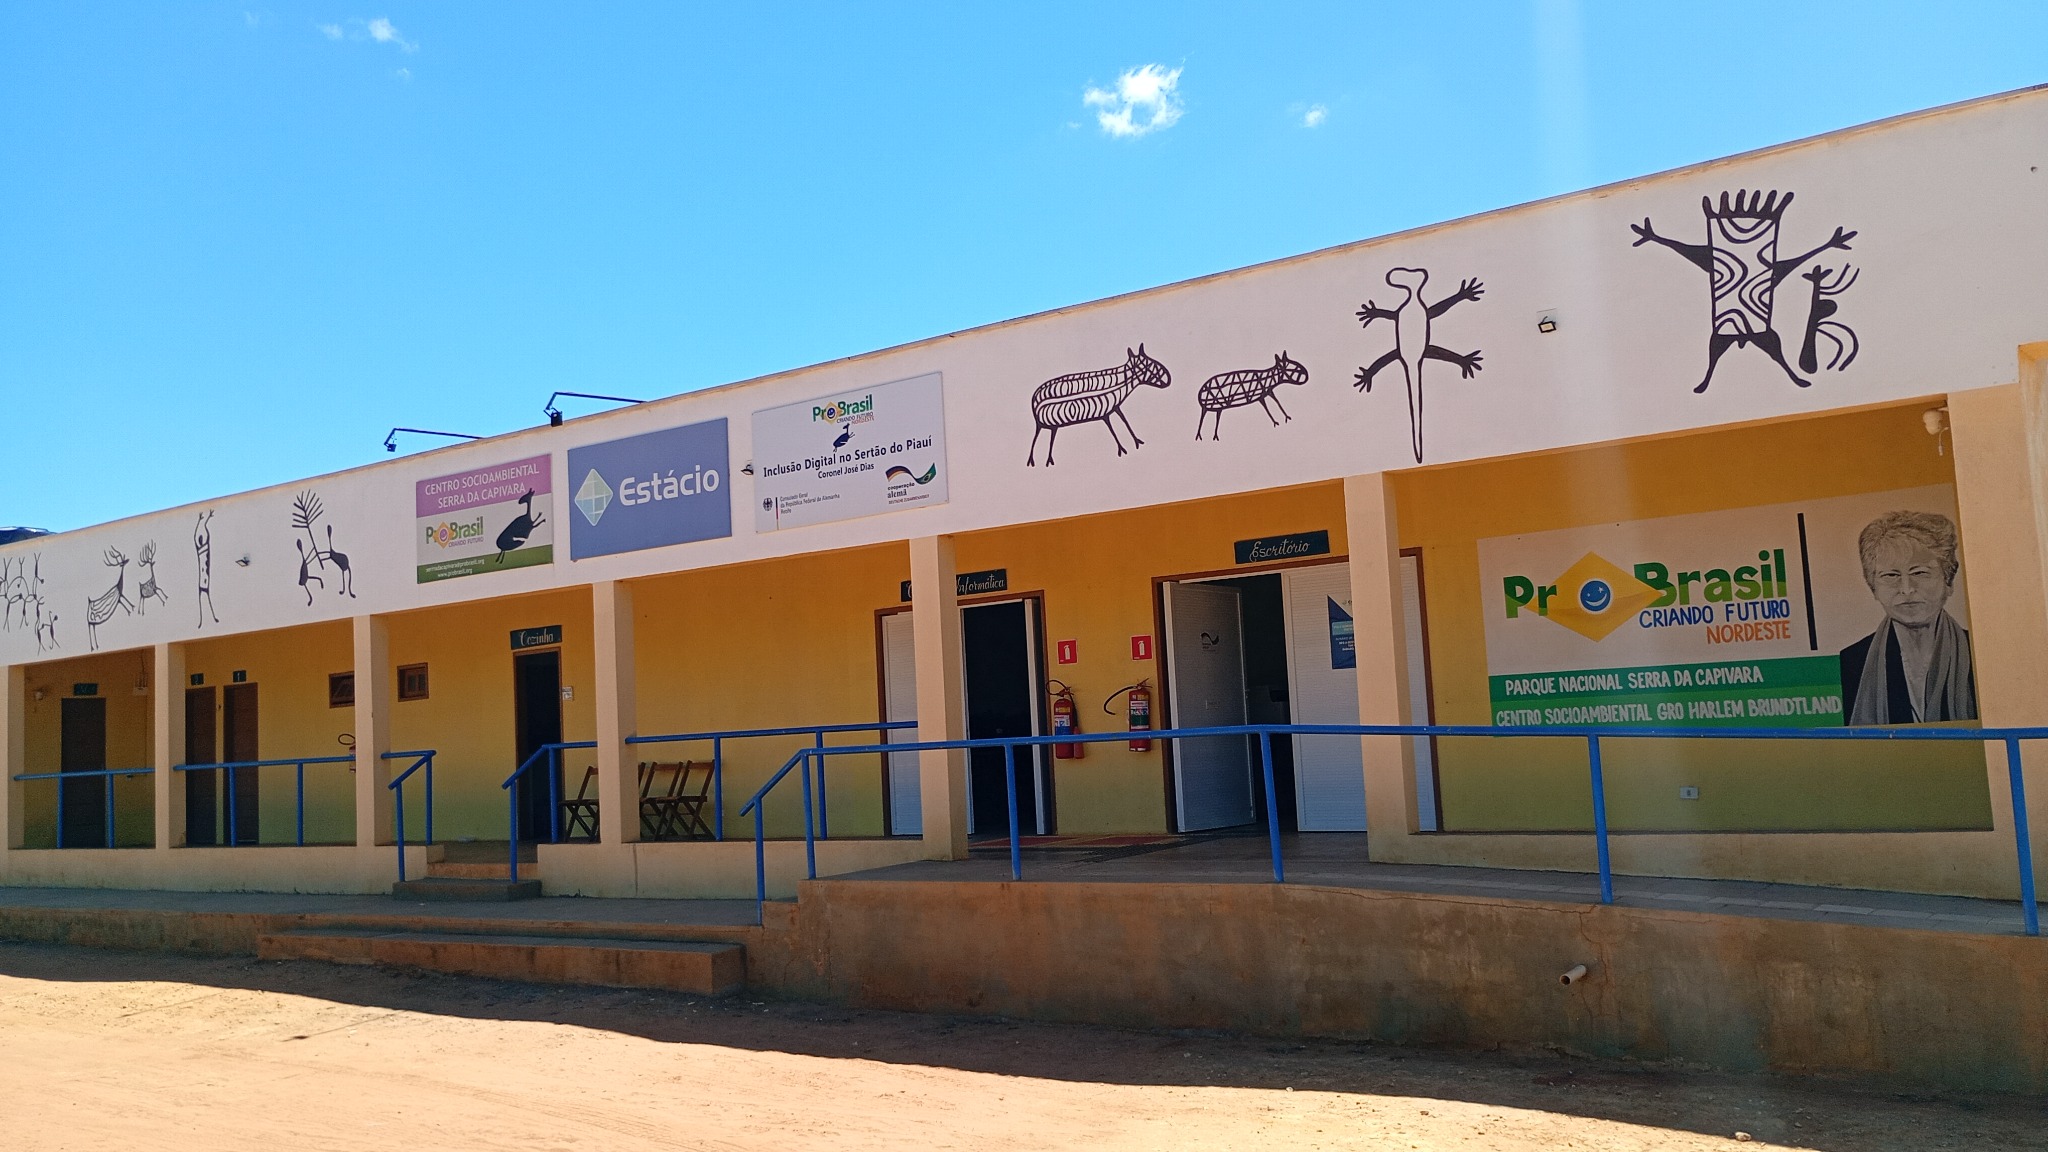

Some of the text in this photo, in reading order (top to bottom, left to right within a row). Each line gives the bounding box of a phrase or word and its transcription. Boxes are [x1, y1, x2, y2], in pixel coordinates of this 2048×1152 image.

[763, 435, 932, 478] Inclusão Digital no Sertão do Piauí
[818, 462, 875, 479] Coronel José Dias
[425, 463, 540, 496] CENTRO SOCIOAMBIENTAL
[619, 464, 720, 506] Estácio
[438, 482, 526, 509] SERRA DA CAPIVARA
[1249, 538, 1310, 562] Escritório
[1639, 599, 1791, 629] CRIANDO FUTURO
[520, 627, 554, 647] Cozinha
[1706, 620, 1792, 645] NORDESTE
[1505, 665, 1764, 696] PARQUE NACIONAL SERRA DA CAPIVARA
[1496, 695, 1843, 727] CENTRO SOCIOAMBIENTAL GRO HARLEM BRUNDTLAND
